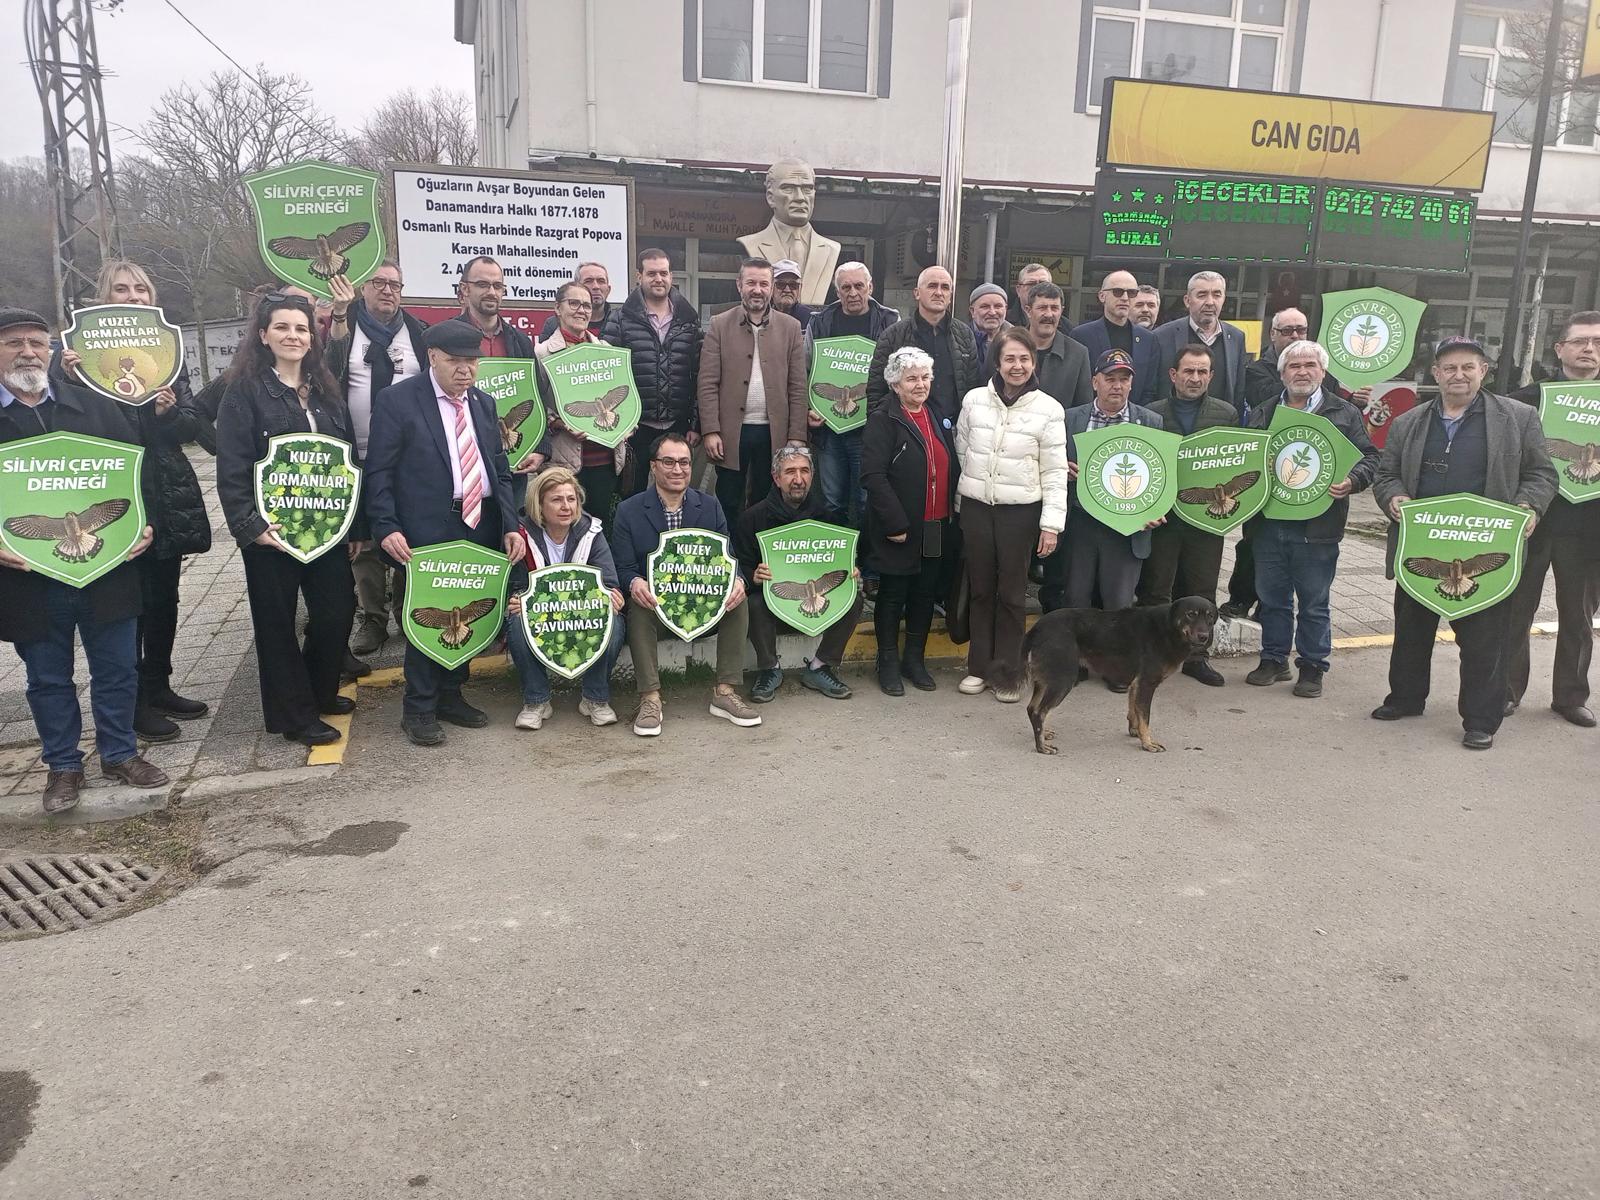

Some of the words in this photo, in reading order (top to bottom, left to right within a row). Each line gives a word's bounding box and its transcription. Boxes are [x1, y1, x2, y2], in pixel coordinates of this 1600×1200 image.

[1251, 119, 1301, 150] CAN
[1307, 124, 1361, 155] GIDA
[263, 184, 314, 199] SİLİVRİ
[316, 184, 364, 200] ÇEVRE
[416, 177, 473, 193] Oğuzların
[476, 180, 510, 196] Avşar
[513, 183, 570, 199] Boyundan
[573, 186, 605, 199] Gelen
[284, 200, 349, 215] DERNEĞİ
[426, 199, 504, 215] Danamandıra
[507, 203, 537, 217] Halkı
[540, 205, 599, 219] 1877.1878
[1325, 190, 1374, 216] 0212
[1381, 195, 1415, 220] 742
[1419, 201, 1443, 222] 40
[1448, 204, 1471, 225] 61
[402, 219, 451, 233] Osmanlı
[454, 222, 476, 235] Rus
[480, 223, 532, 237] Harbinde
[535, 225, 579, 241] Razgrat
[582, 227, 622, 242] Popova
[451, 242, 493, 256] Karsan
[496, 244, 578, 259] Mahallesinden
[441, 263, 452, 275] 2.
[1343, 302, 1388, 321] ÇEVRE
[98, 316, 138, 327] KUZEY
[82, 327, 159, 339] ORMANLARI
[84, 338, 161, 350] SAVUNMASI
[822, 346, 855, 360] SİLİVRİ
[855, 352, 874, 363] ÇEV
[555, 361, 589, 375] SİLİVRİ
[590, 357, 622, 371] ÇEVRE
[1350, 360, 1371, 369] 1989
[490, 369, 526, 388] ÇEVRE
[570, 371, 614, 386] DERNEĞİ
[1553, 393, 1600, 411] SİLİVR
[1286, 428, 1328, 450] ÇEVRE
[289, 451, 331, 464] KUZEY
[1098, 439, 1144, 460] ÇEVRE
[1177, 444, 1218, 460] SİLİVRİ
[1219, 441, 1259, 456] ÇEVRE
[2, 456, 66, 473] SİLİVRİ
[68, 458, 126, 474] ÇEVRE
[1192, 455, 1246, 471] DERNEĞİ
[27, 473, 108, 491] DERNEĞİ
[268, 472, 348, 489] ORMANLARI
[1272, 485, 1291, 500] 1989
[268, 495, 346, 510] SAVUNMASI
[1114, 503, 1137, 511] 1989
[1413, 511, 1464, 528] SİLİVRİ
[1465, 515, 1514, 530] ÇEVRE
[1428, 528, 1495, 543] DERNEĞİ
[676, 543, 712, 556] KUZEY
[772, 538, 811, 551] SİLİVRİ
[812, 539, 847, 553] ÇEVRE
[785, 551, 836, 564] DERNEĞİ
[418, 559, 462, 574] SİLİVRİ
[463, 563, 501, 576] ÇEVRE
[658, 562, 726, 576] ORMANLARI
[431, 576, 487, 590] DERNEĞİ
[548, 579, 586, 592] KUZEY
[658, 582, 724, 596] SAVUNMASI
[532, 598, 604, 614] ORMANLARI
[534, 618, 604, 634] SAVUNMASI
